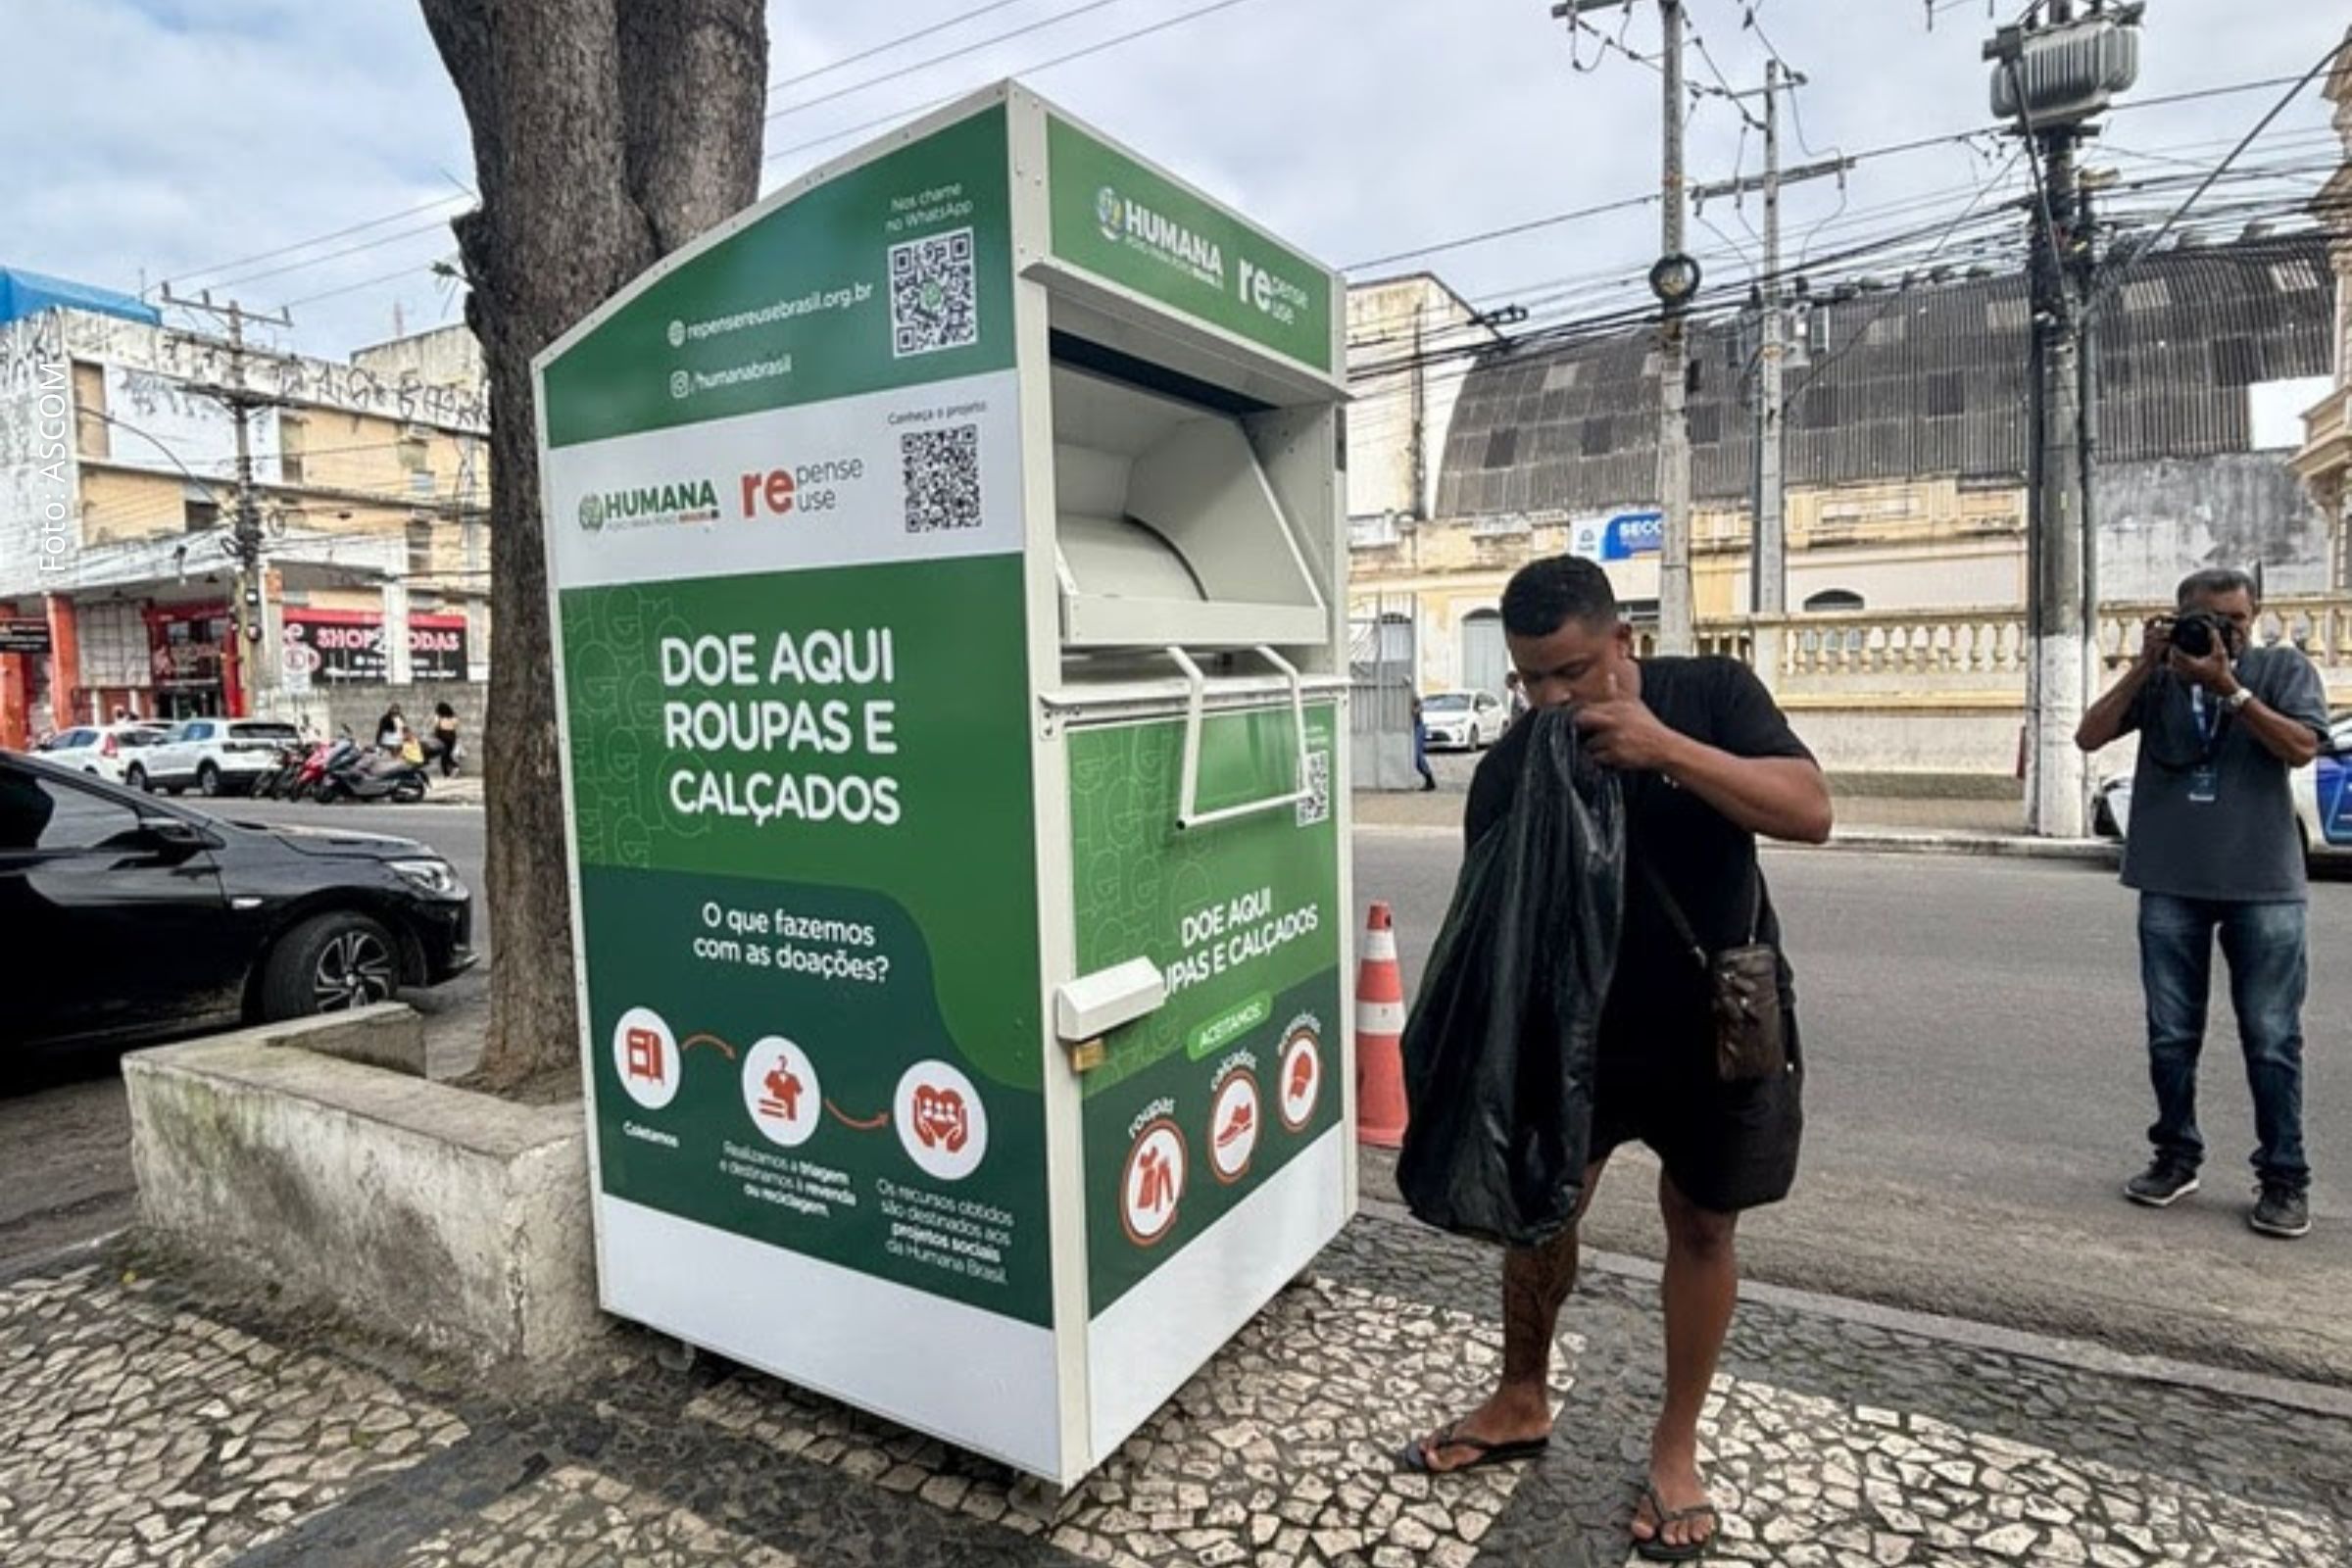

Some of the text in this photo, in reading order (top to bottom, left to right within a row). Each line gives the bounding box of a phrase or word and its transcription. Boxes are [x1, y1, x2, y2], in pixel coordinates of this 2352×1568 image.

[905, 200, 973, 227] WhatsApp
[1126, 199, 1224, 276] HUMANA
[688, 281, 872, 339] repensereusebrasil.org.br
[1239, 258, 1273, 313] re
[605, 479, 718, 518] HUMANA
[741, 457, 864, 518] re pense
[798, 491, 836, 513] use
[661, 627, 894, 686] DOE AQUI
[663, 700, 898, 754] ROUPAS E
[669, 770, 901, 826] CALÇADOS
[702, 902, 875, 947] O que fazemos
[1181, 886, 1271, 949] DOE AQUI
[1213, 942, 1227, 974] E
[1228, 903, 1318, 965] CALÇADOS
[693, 937, 889, 982] com as doações?
[622, 1120, 680, 1148] Coletamos
[876, 1178, 1014, 1227] Os recursos obtidos
[882, 1198, 1011, 1247] são destinados aos
[891, 1222, 1001, 1263] projetos sociais
[905, 1241, 965, 1273] Humana
